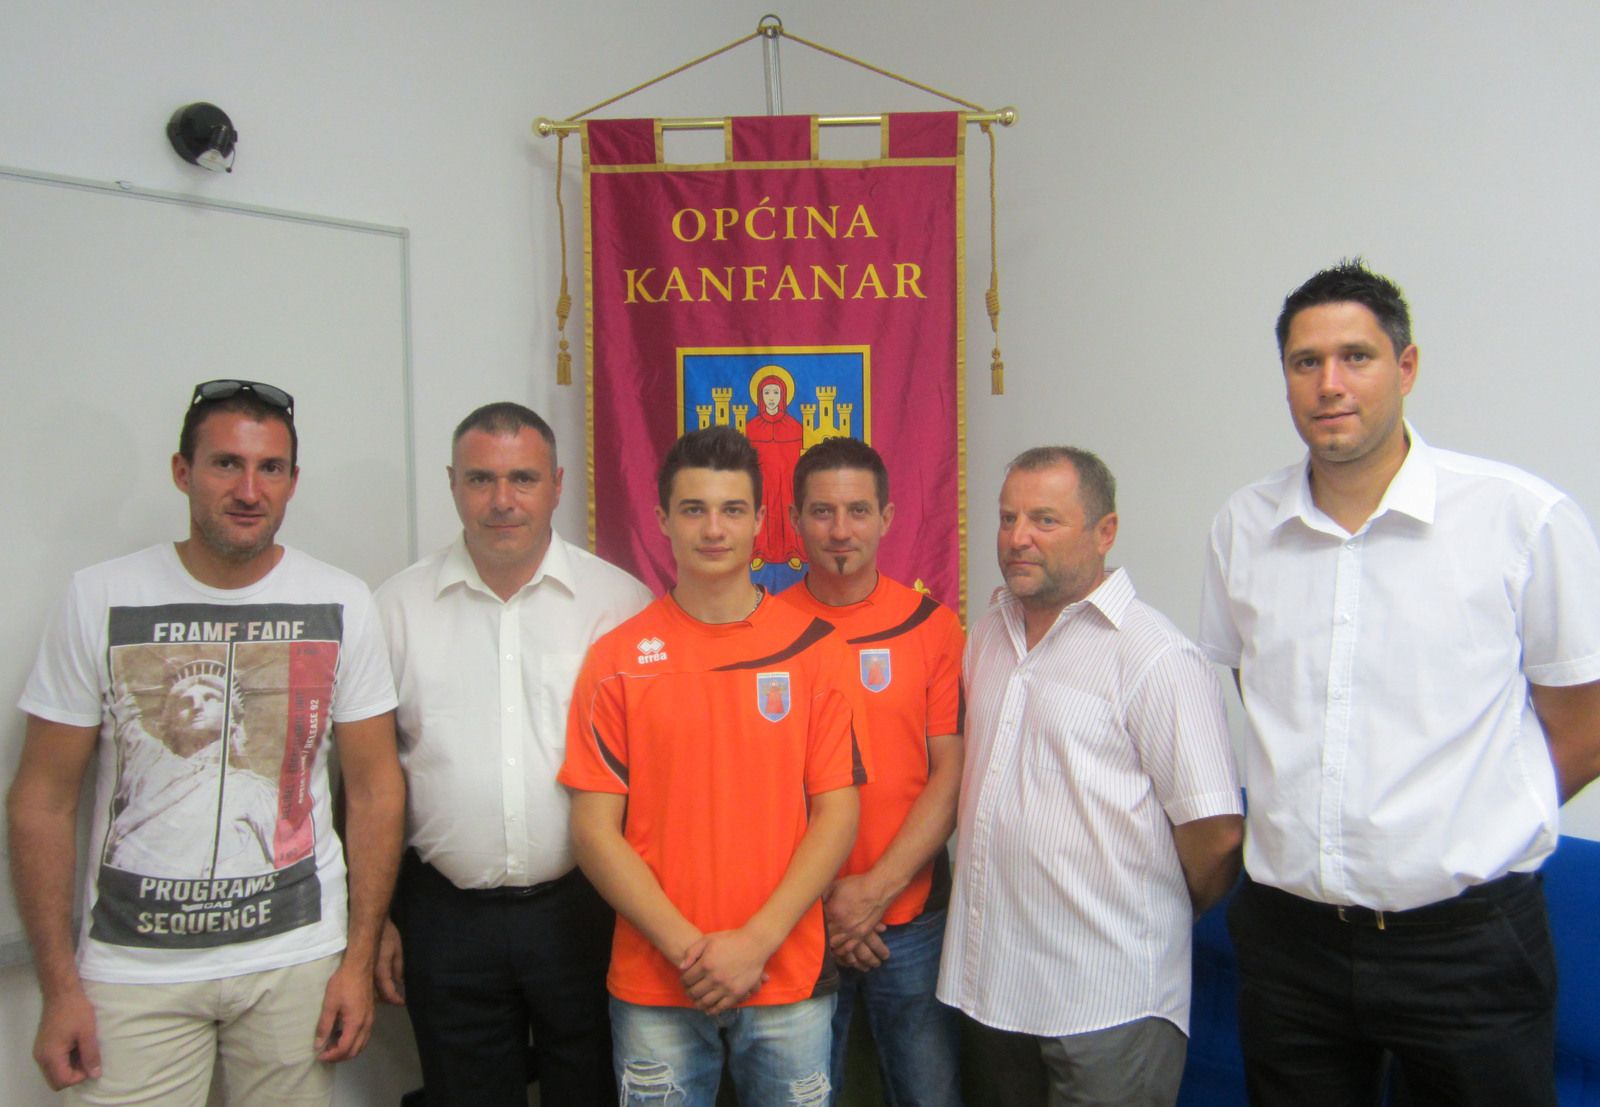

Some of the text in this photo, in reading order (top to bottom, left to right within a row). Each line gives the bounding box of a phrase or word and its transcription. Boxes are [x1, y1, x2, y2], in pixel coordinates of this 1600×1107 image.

[671, 196, 879, 242] OPĆINA
[623, 263, 928, 304] KANFANAR
[139, 873, 280, 902] PROGRAMS
[136, 899, 273, 935] SEQUENCE
